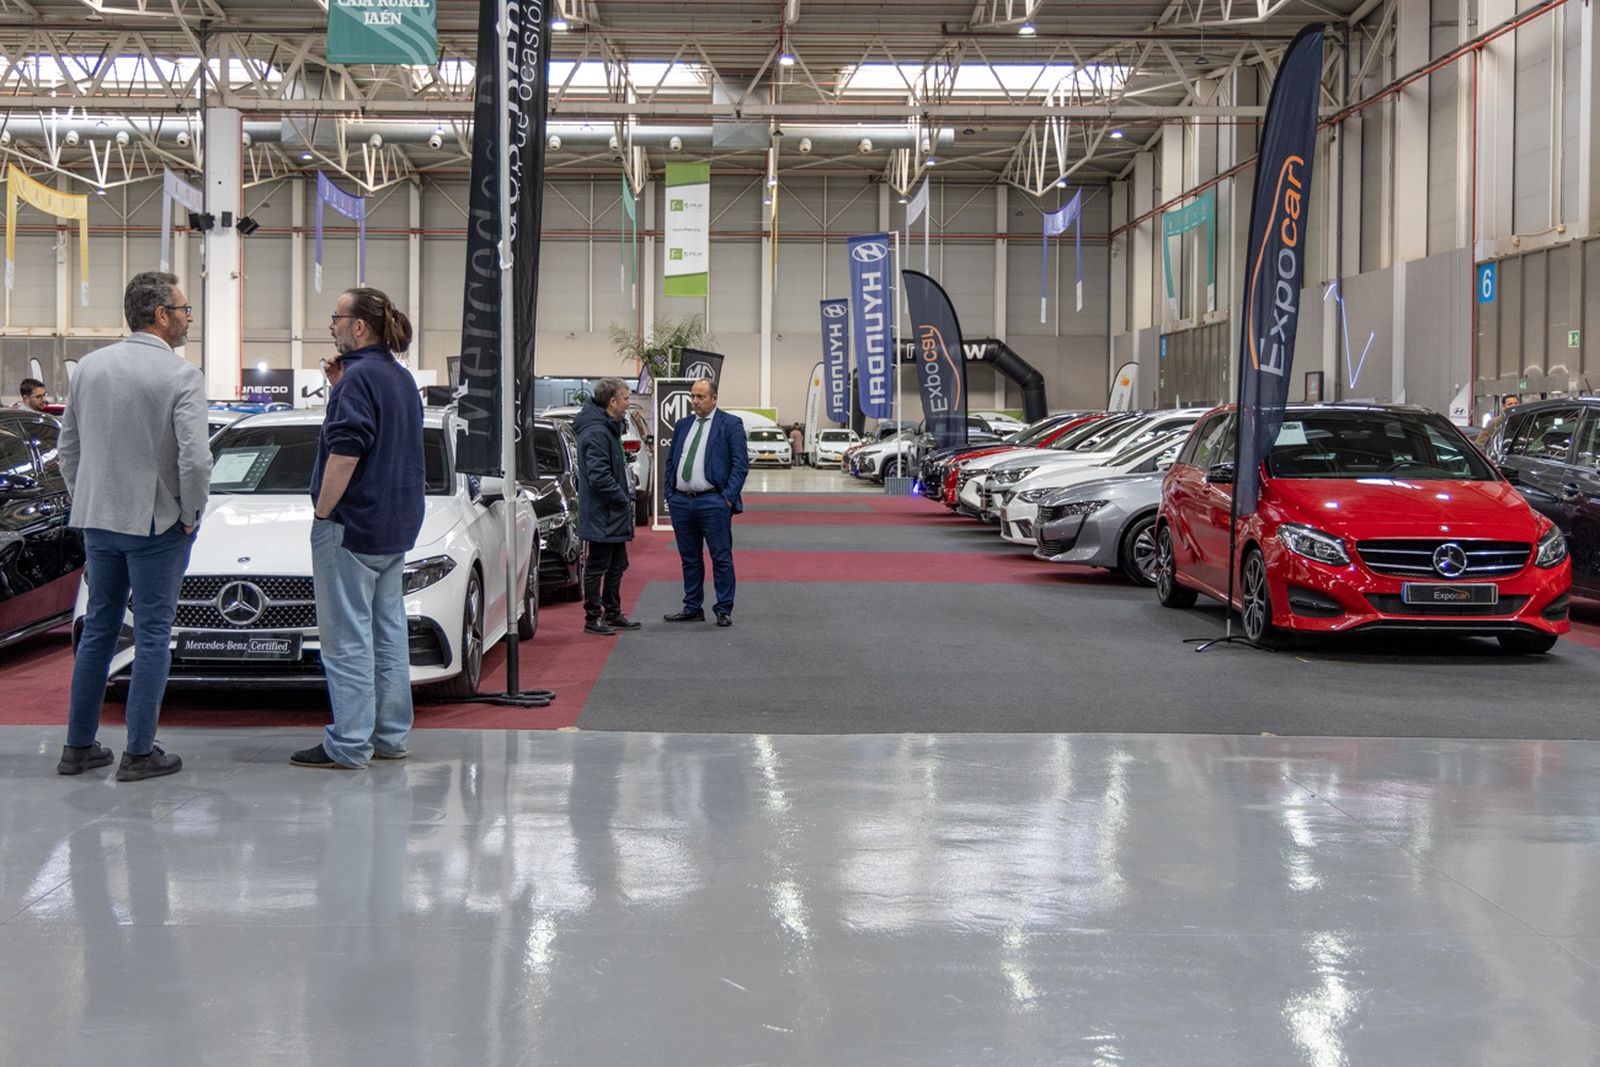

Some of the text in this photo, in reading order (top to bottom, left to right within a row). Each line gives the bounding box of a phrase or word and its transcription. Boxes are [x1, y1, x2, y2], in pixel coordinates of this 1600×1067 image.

[363, 9, 402, 25] JAÉN
[519, 0, 543, 101] ocasió
[1259, 162, 1304, 377] Expocar
[1482, 269, 1492, 298] 6
[1433, 591, 1468, 600] Expocar
[185, 640, 289, 652] Mercedes-Benz Certified
